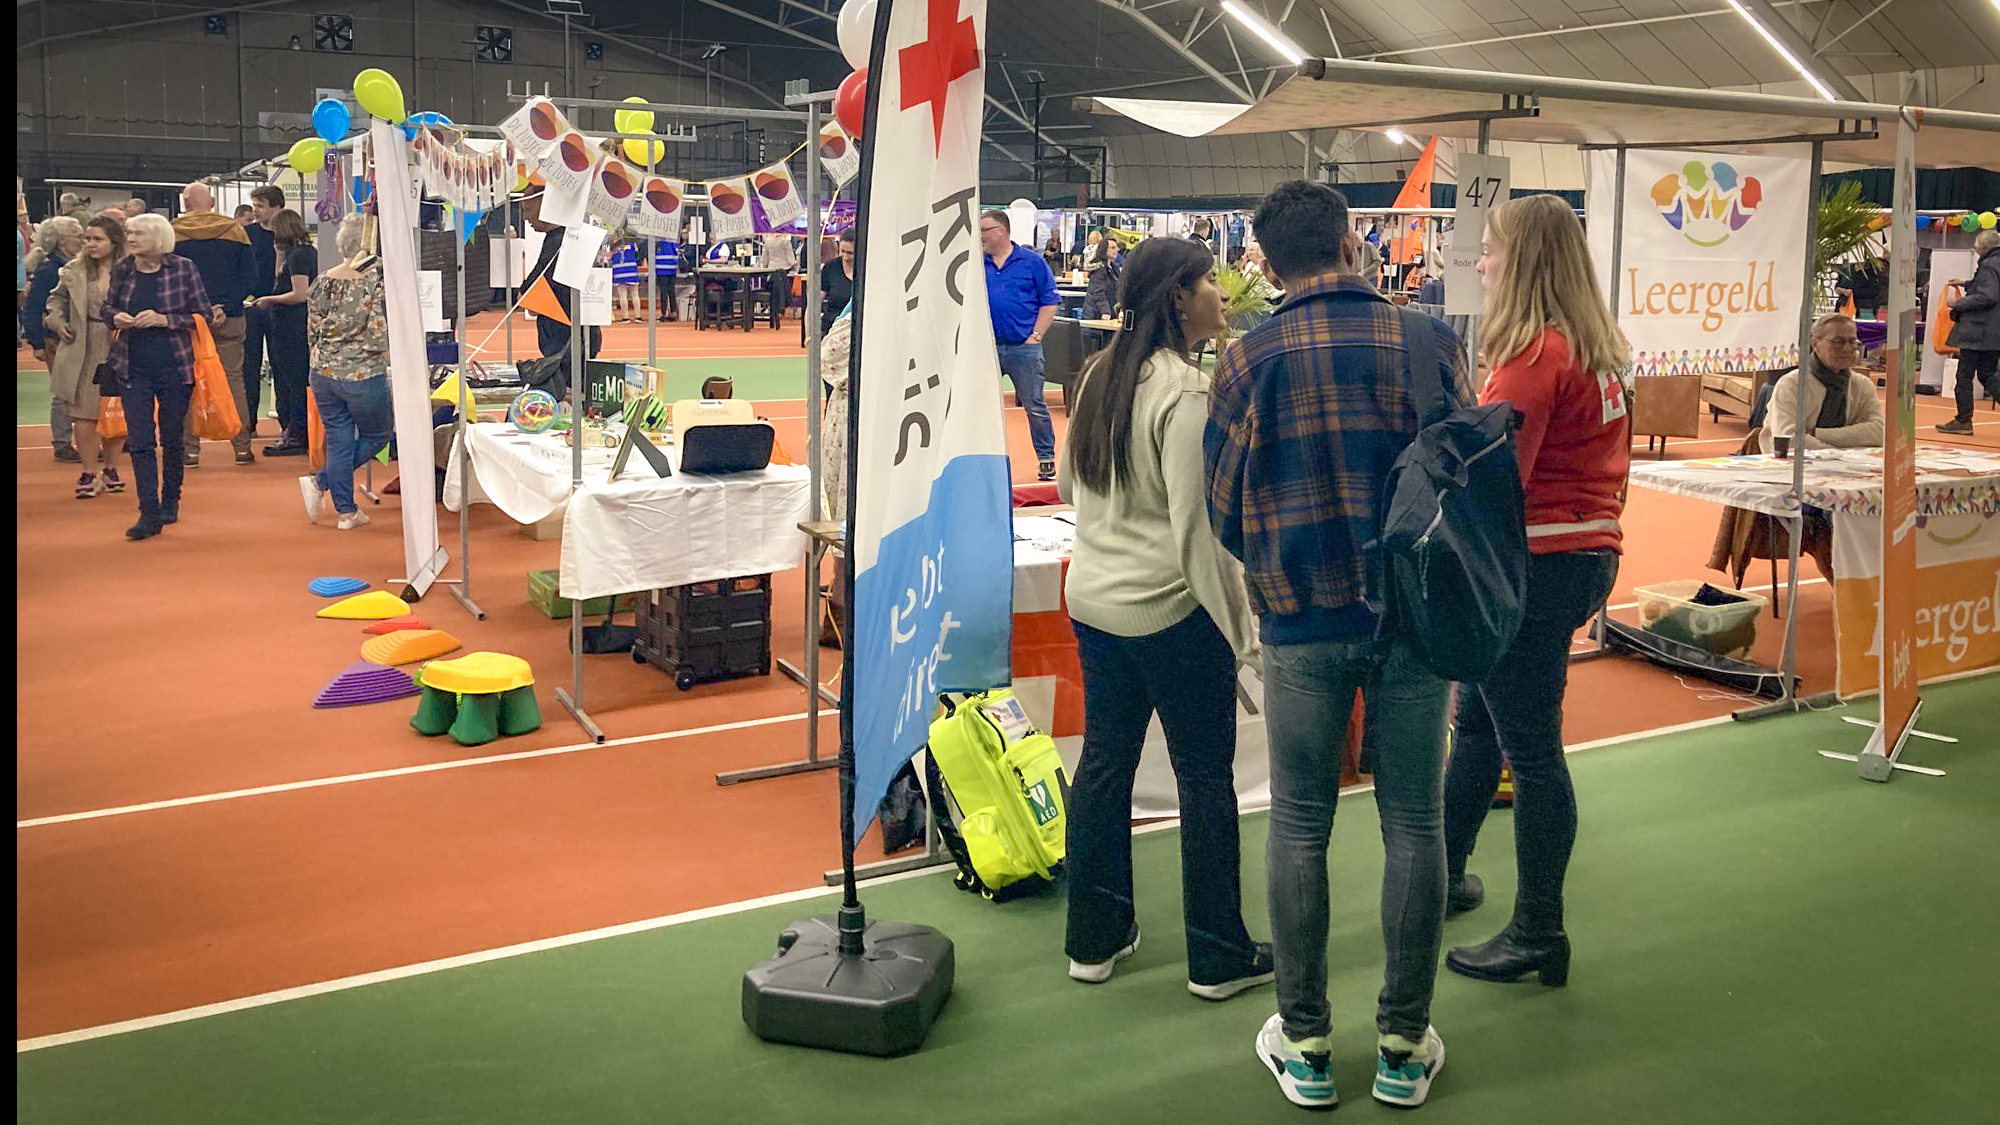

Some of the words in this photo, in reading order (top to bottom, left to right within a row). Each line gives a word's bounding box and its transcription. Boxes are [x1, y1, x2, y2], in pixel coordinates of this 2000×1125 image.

[1465, 176, 1502, 208] 47
[1453, 258, 1472, 267] Rode
[1627, 260, 1779, 333] Leergeld
[592, 382, 604, 401] DE
[1040, 806, 1057, 822] AED
